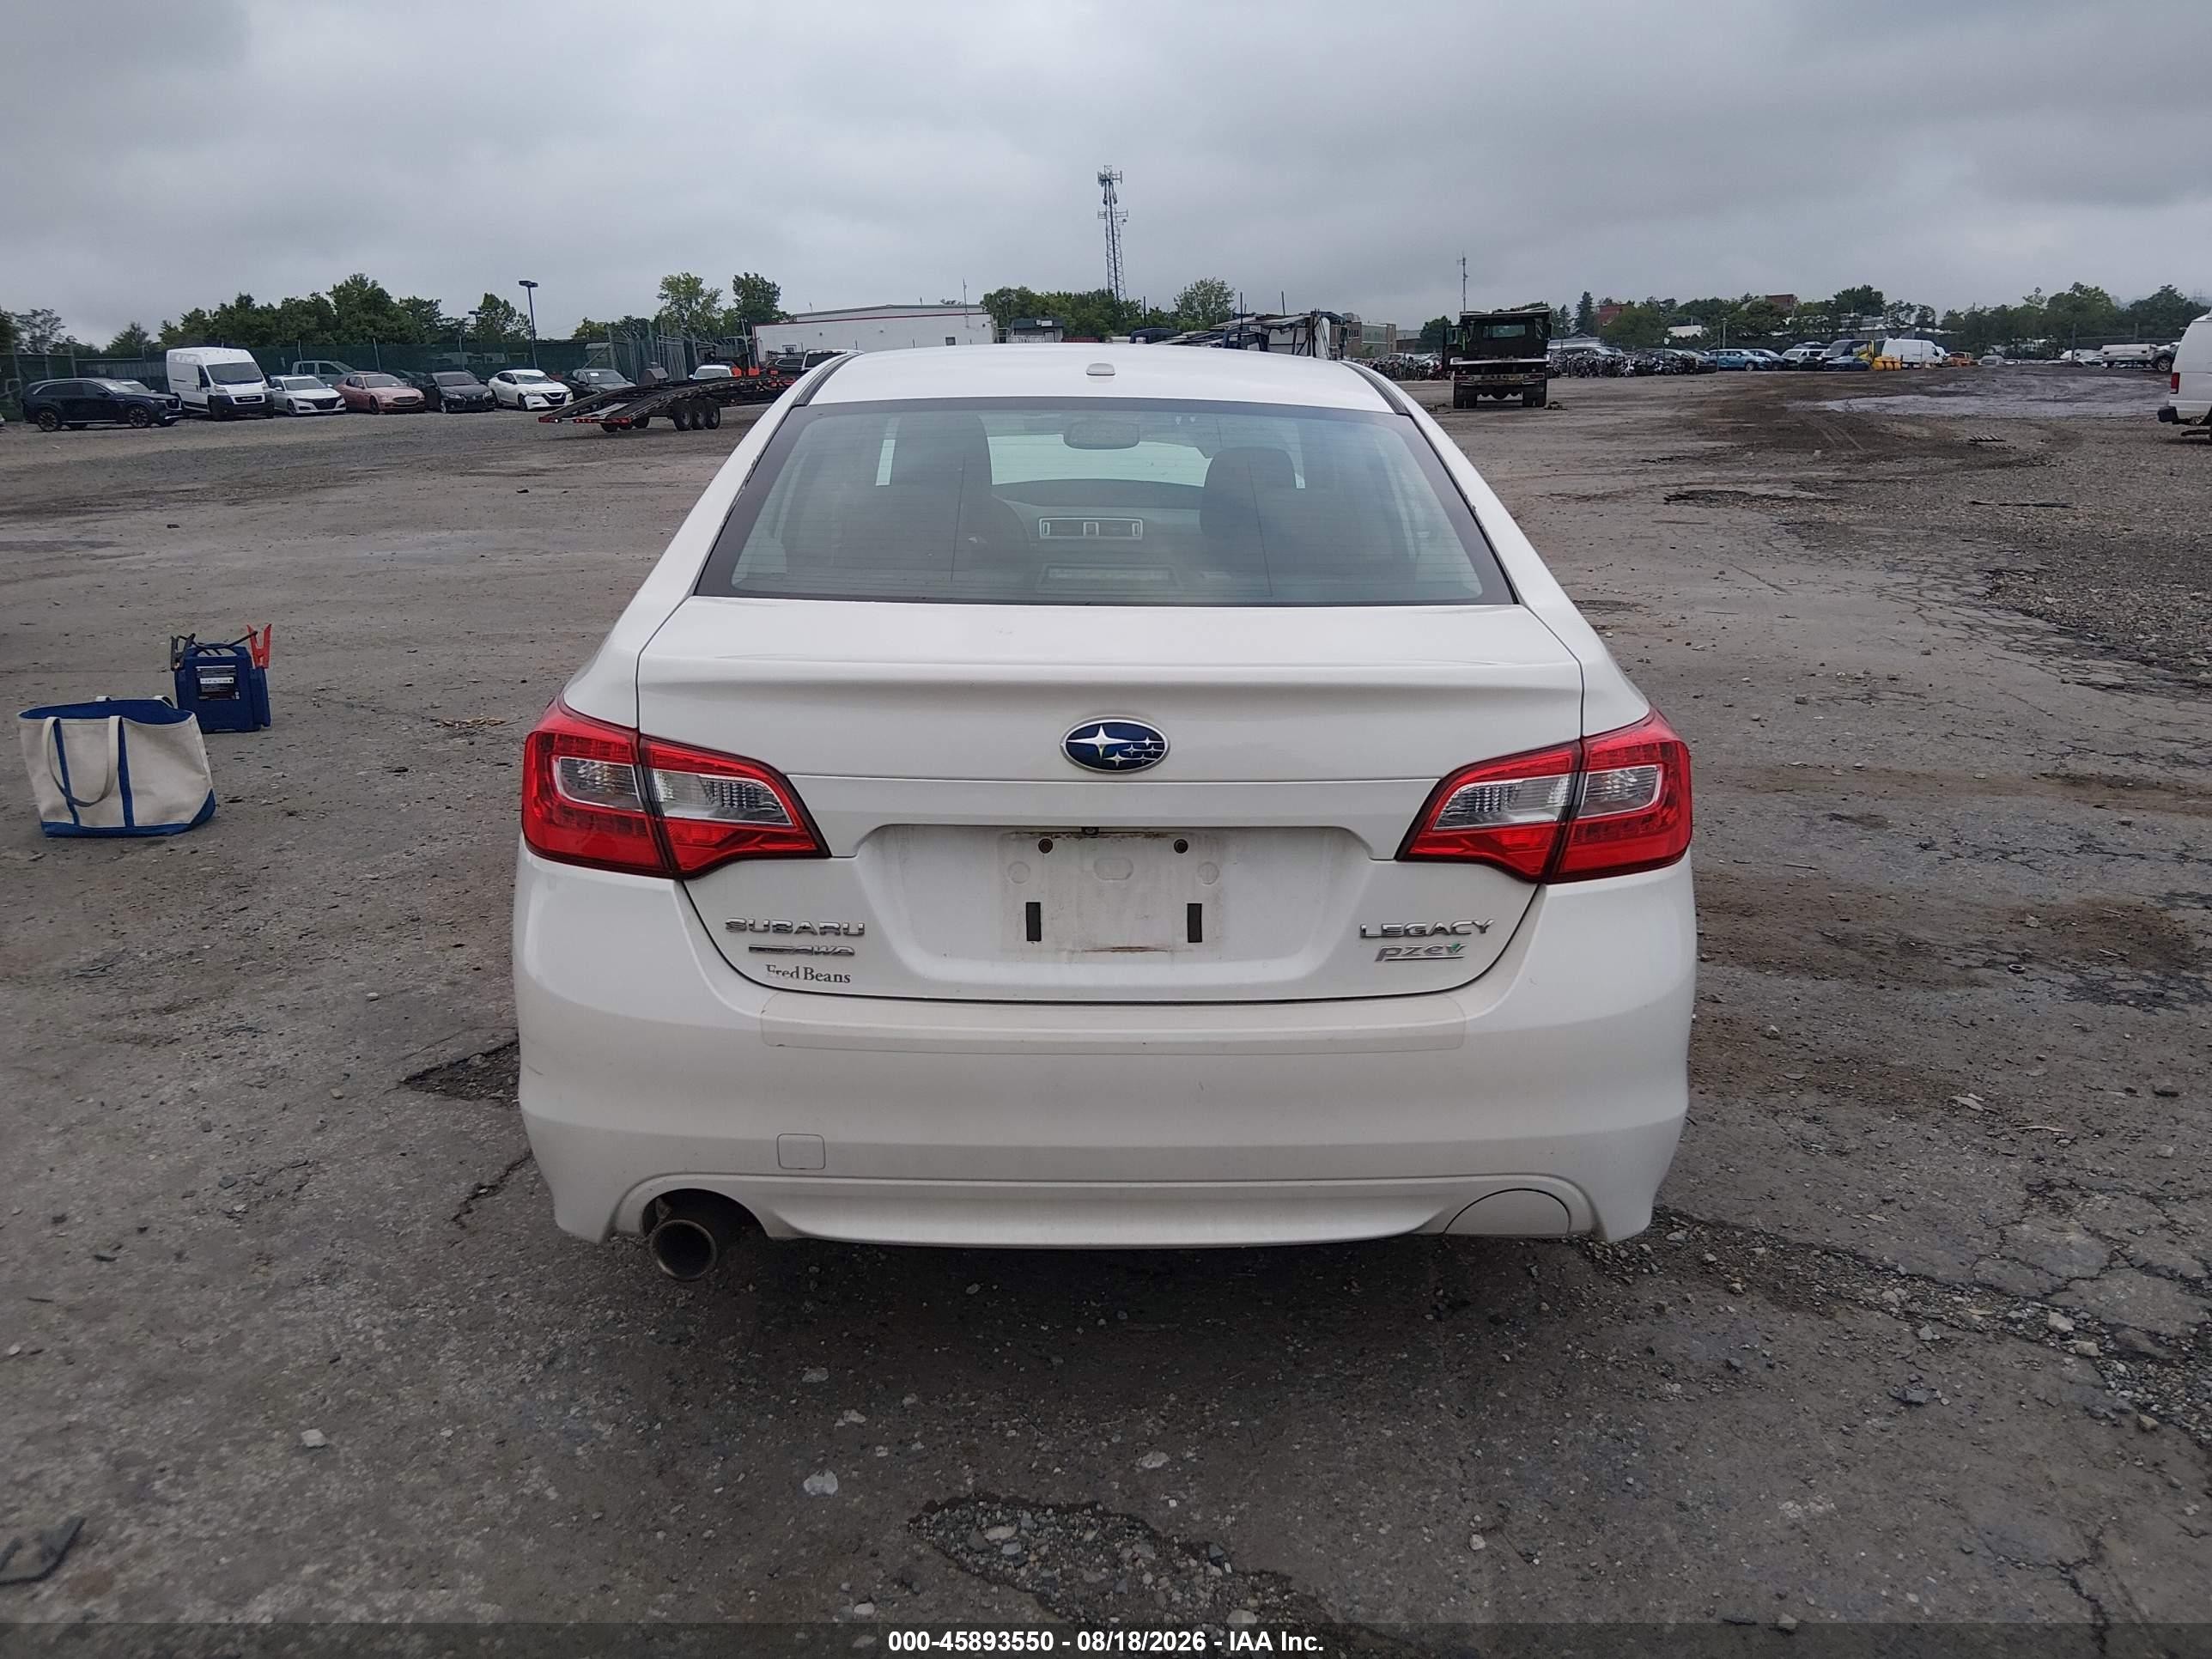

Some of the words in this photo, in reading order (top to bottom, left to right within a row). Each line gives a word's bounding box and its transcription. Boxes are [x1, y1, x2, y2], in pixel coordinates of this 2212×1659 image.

[725, 917, 866, 937] SUBARU
[1359, 919, 1494, 939] LEGACY
[791, 945, 855, 957] AWD
[765, 963, 800, 980] Fred
[803, 966, 852, 984] Beans
